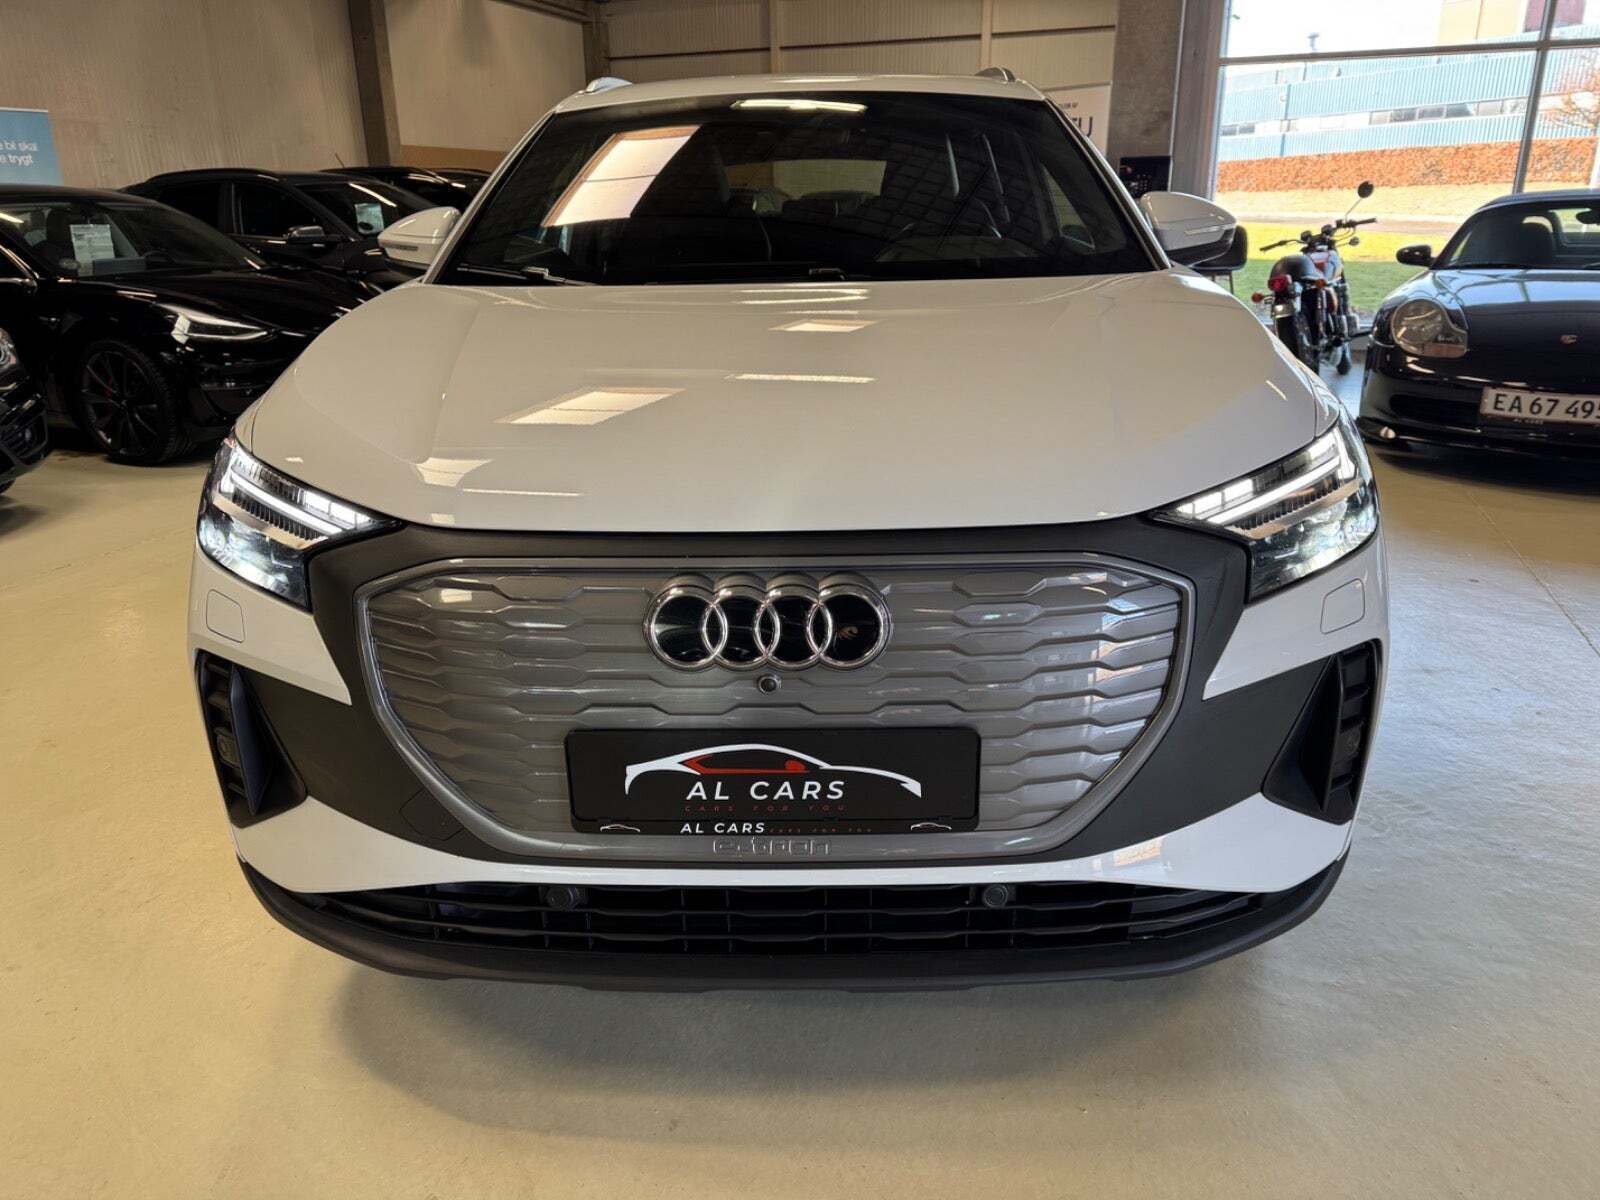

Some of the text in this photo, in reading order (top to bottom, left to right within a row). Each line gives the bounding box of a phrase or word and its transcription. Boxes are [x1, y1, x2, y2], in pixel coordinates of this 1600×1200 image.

[1493, 393, 1600, 419] EA 67 49
[686, 781, 845, 800] AL CARS
[808, 803, 845, 812] YOU
[680, 823, 704, 834] AL
[714, 822, 765, 834] CARS
